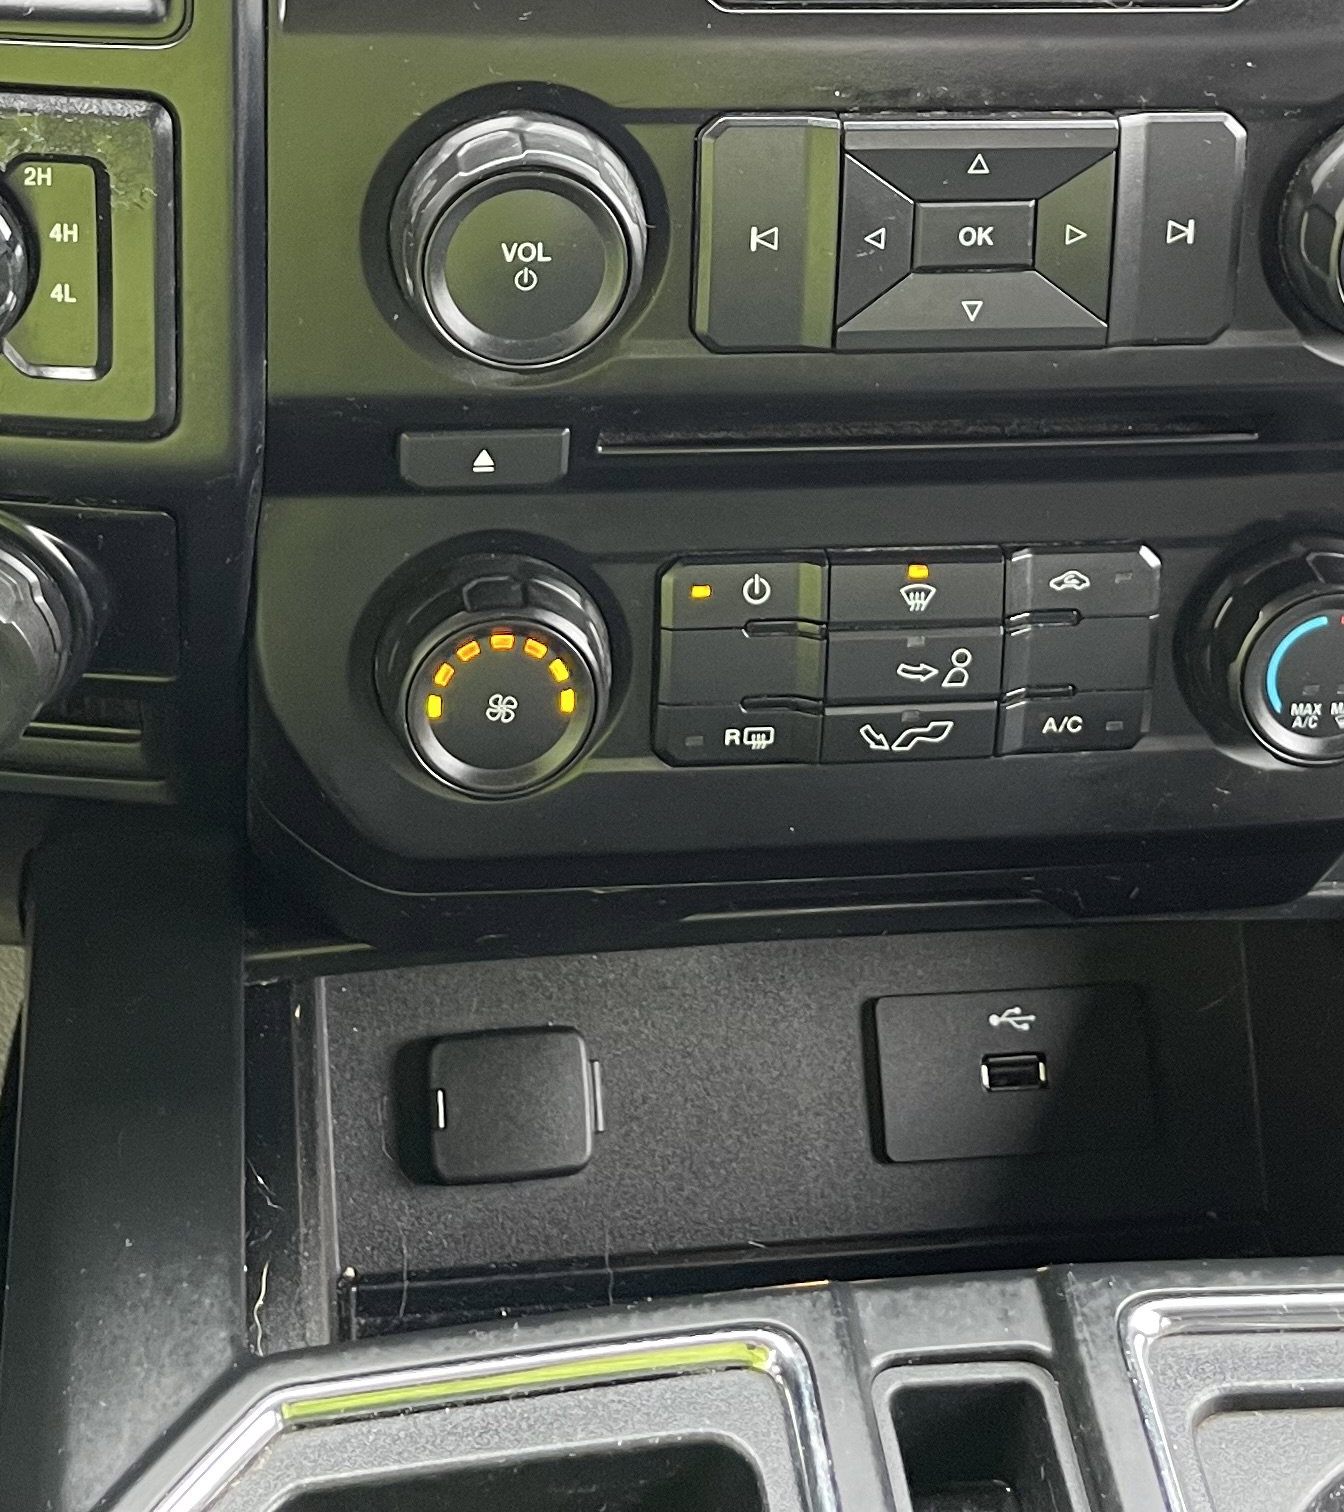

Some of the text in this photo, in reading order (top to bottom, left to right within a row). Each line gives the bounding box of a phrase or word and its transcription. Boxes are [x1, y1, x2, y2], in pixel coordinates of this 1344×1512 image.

[23, 166, 52, 187] 2H
[48, 223, 78, 243] 4H
[958, 226, 994, 247] OK
[501, 241, 552, 263] VOL
[50, 283, 77, 303] 4L
[1290, 702, 1323, 716] MAX
[1041, 715, 1083, 734] A/C
[1291, 715, 1320, 729] A/C
